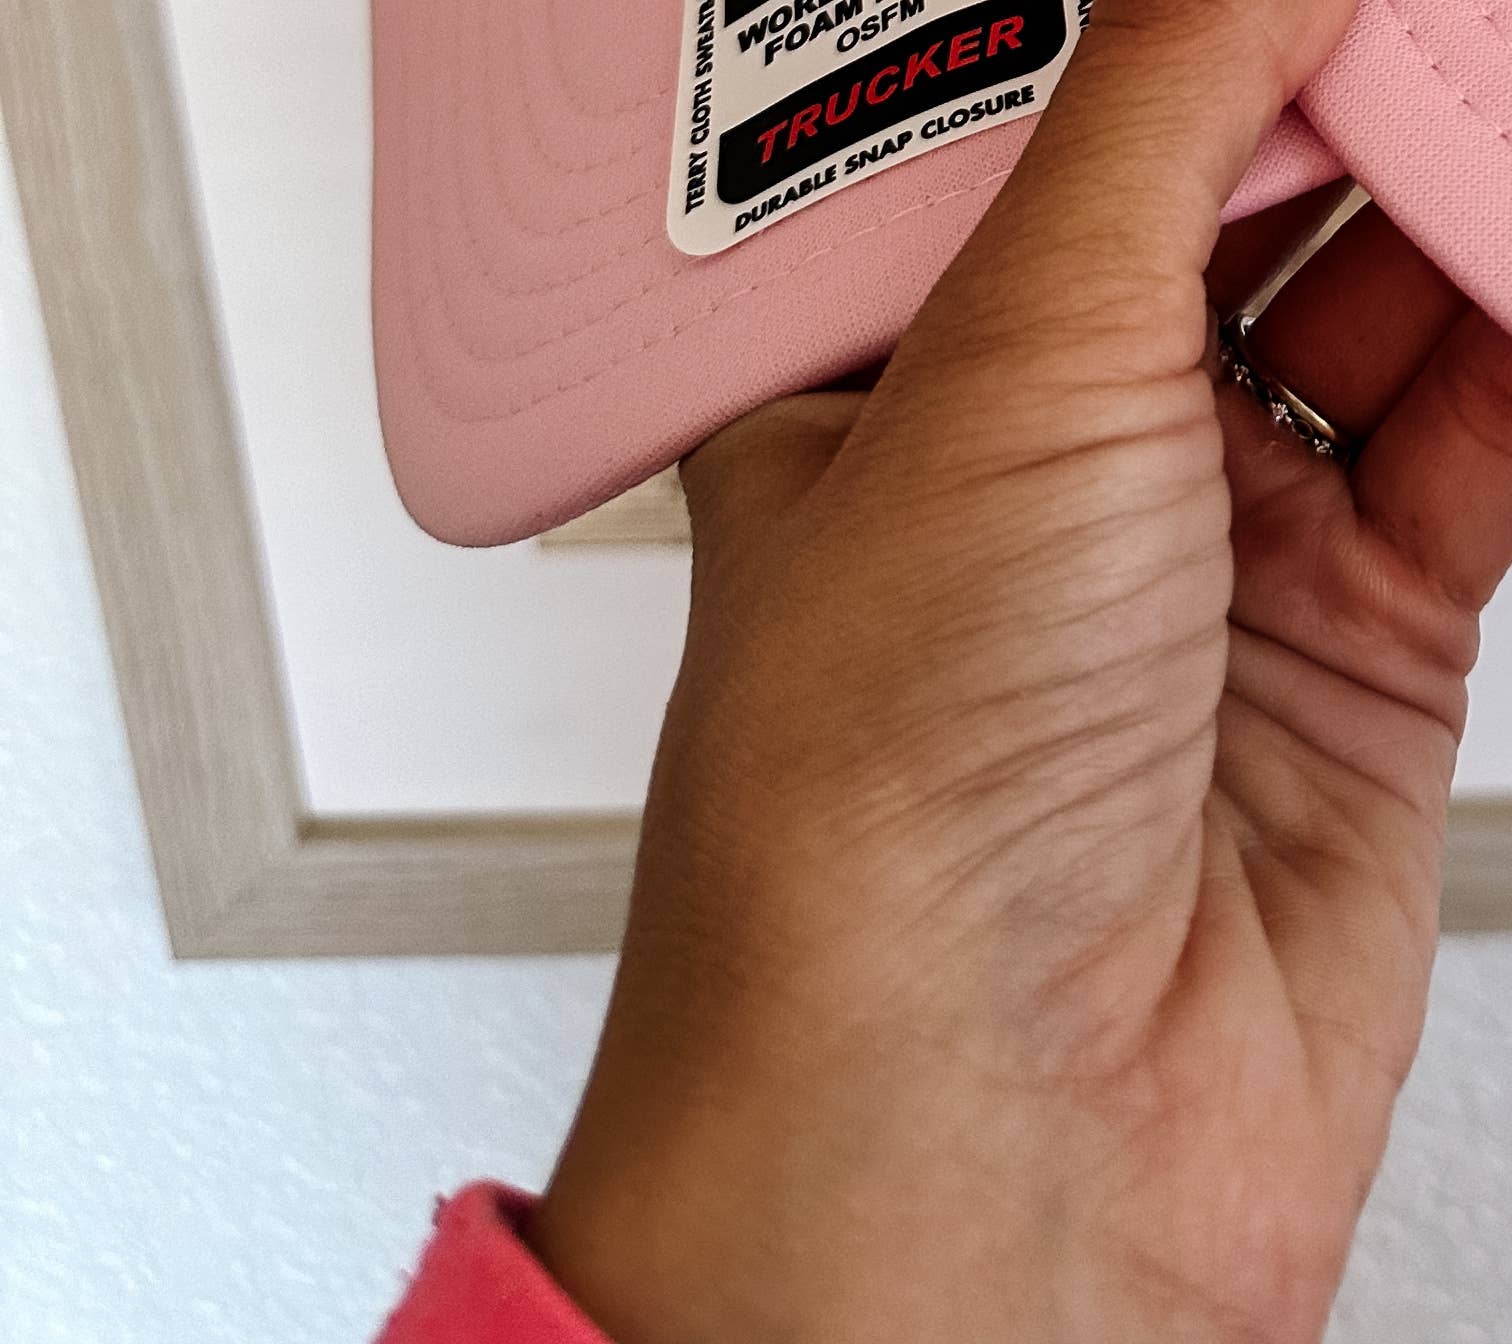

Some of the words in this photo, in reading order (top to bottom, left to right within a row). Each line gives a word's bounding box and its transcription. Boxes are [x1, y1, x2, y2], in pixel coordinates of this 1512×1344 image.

[691, 78, 712, 146] CLOTH
[757, 15, 1025, 165] TRUCKER
[685, 153, 708, 214] TERRY
[734, 165, 837, 232] DURABLE
[845, 130, 913, 175] SNAP
[921, 85, 1035, 140] CLOSURE
